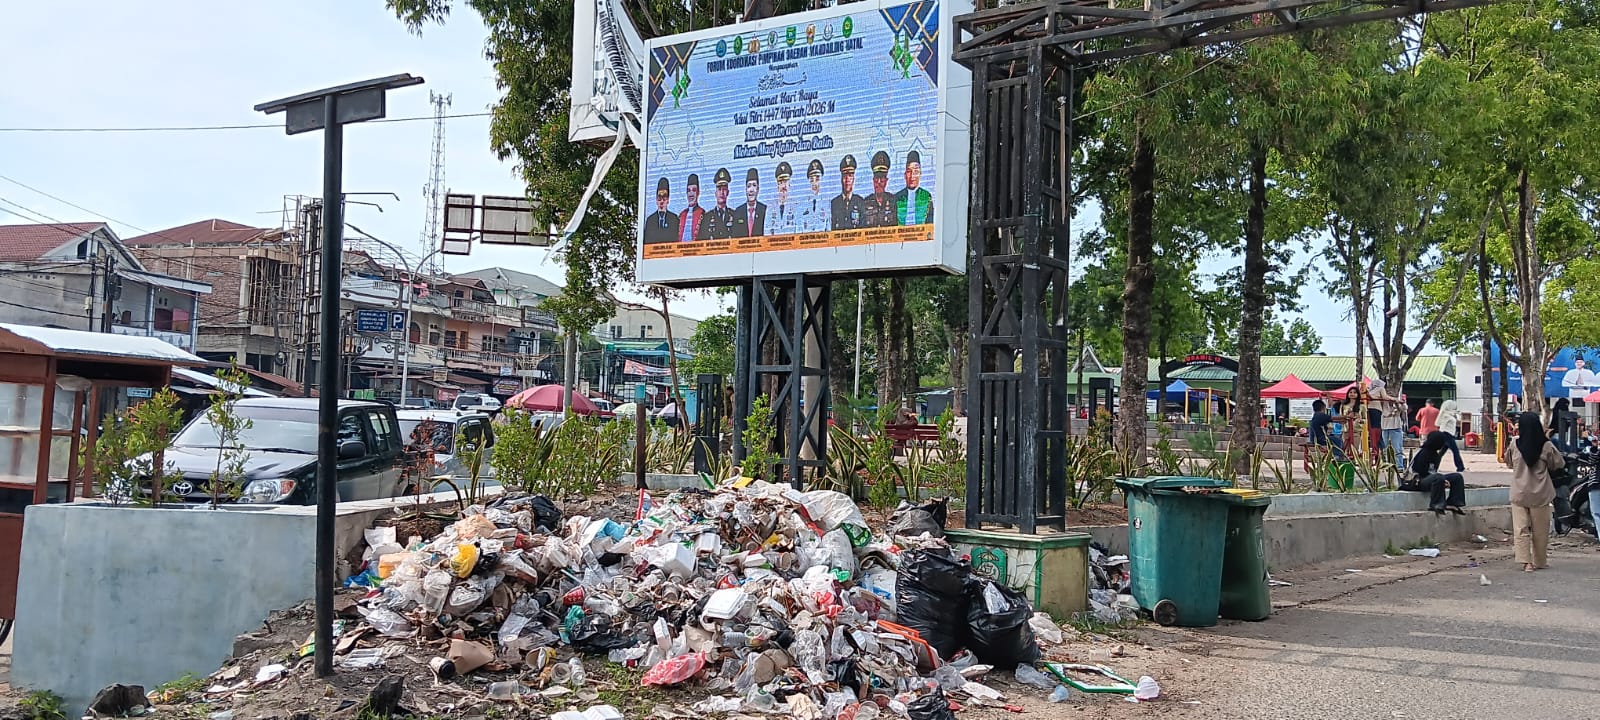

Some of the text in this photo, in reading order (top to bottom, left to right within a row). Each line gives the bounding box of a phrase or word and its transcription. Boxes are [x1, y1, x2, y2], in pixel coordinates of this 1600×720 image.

[706, 37, 864, 73] FORUM KOORDINASI PIMPINAN DAERAH MANDAILING NATAL
[748, 89, 819, 108] Selamat Hari Raya
[733, 110, 748, 125] Idul
[749, 107, 763, 124] Fitri
[764, 107, 780, 121] 1447
[827, 100, 835, 113] M
[745, 126, 766, 141] Minal
[733, 135, 834, 159] Mohon Maaf Lahir dan Batin
[393, 314, 403, 327] P
